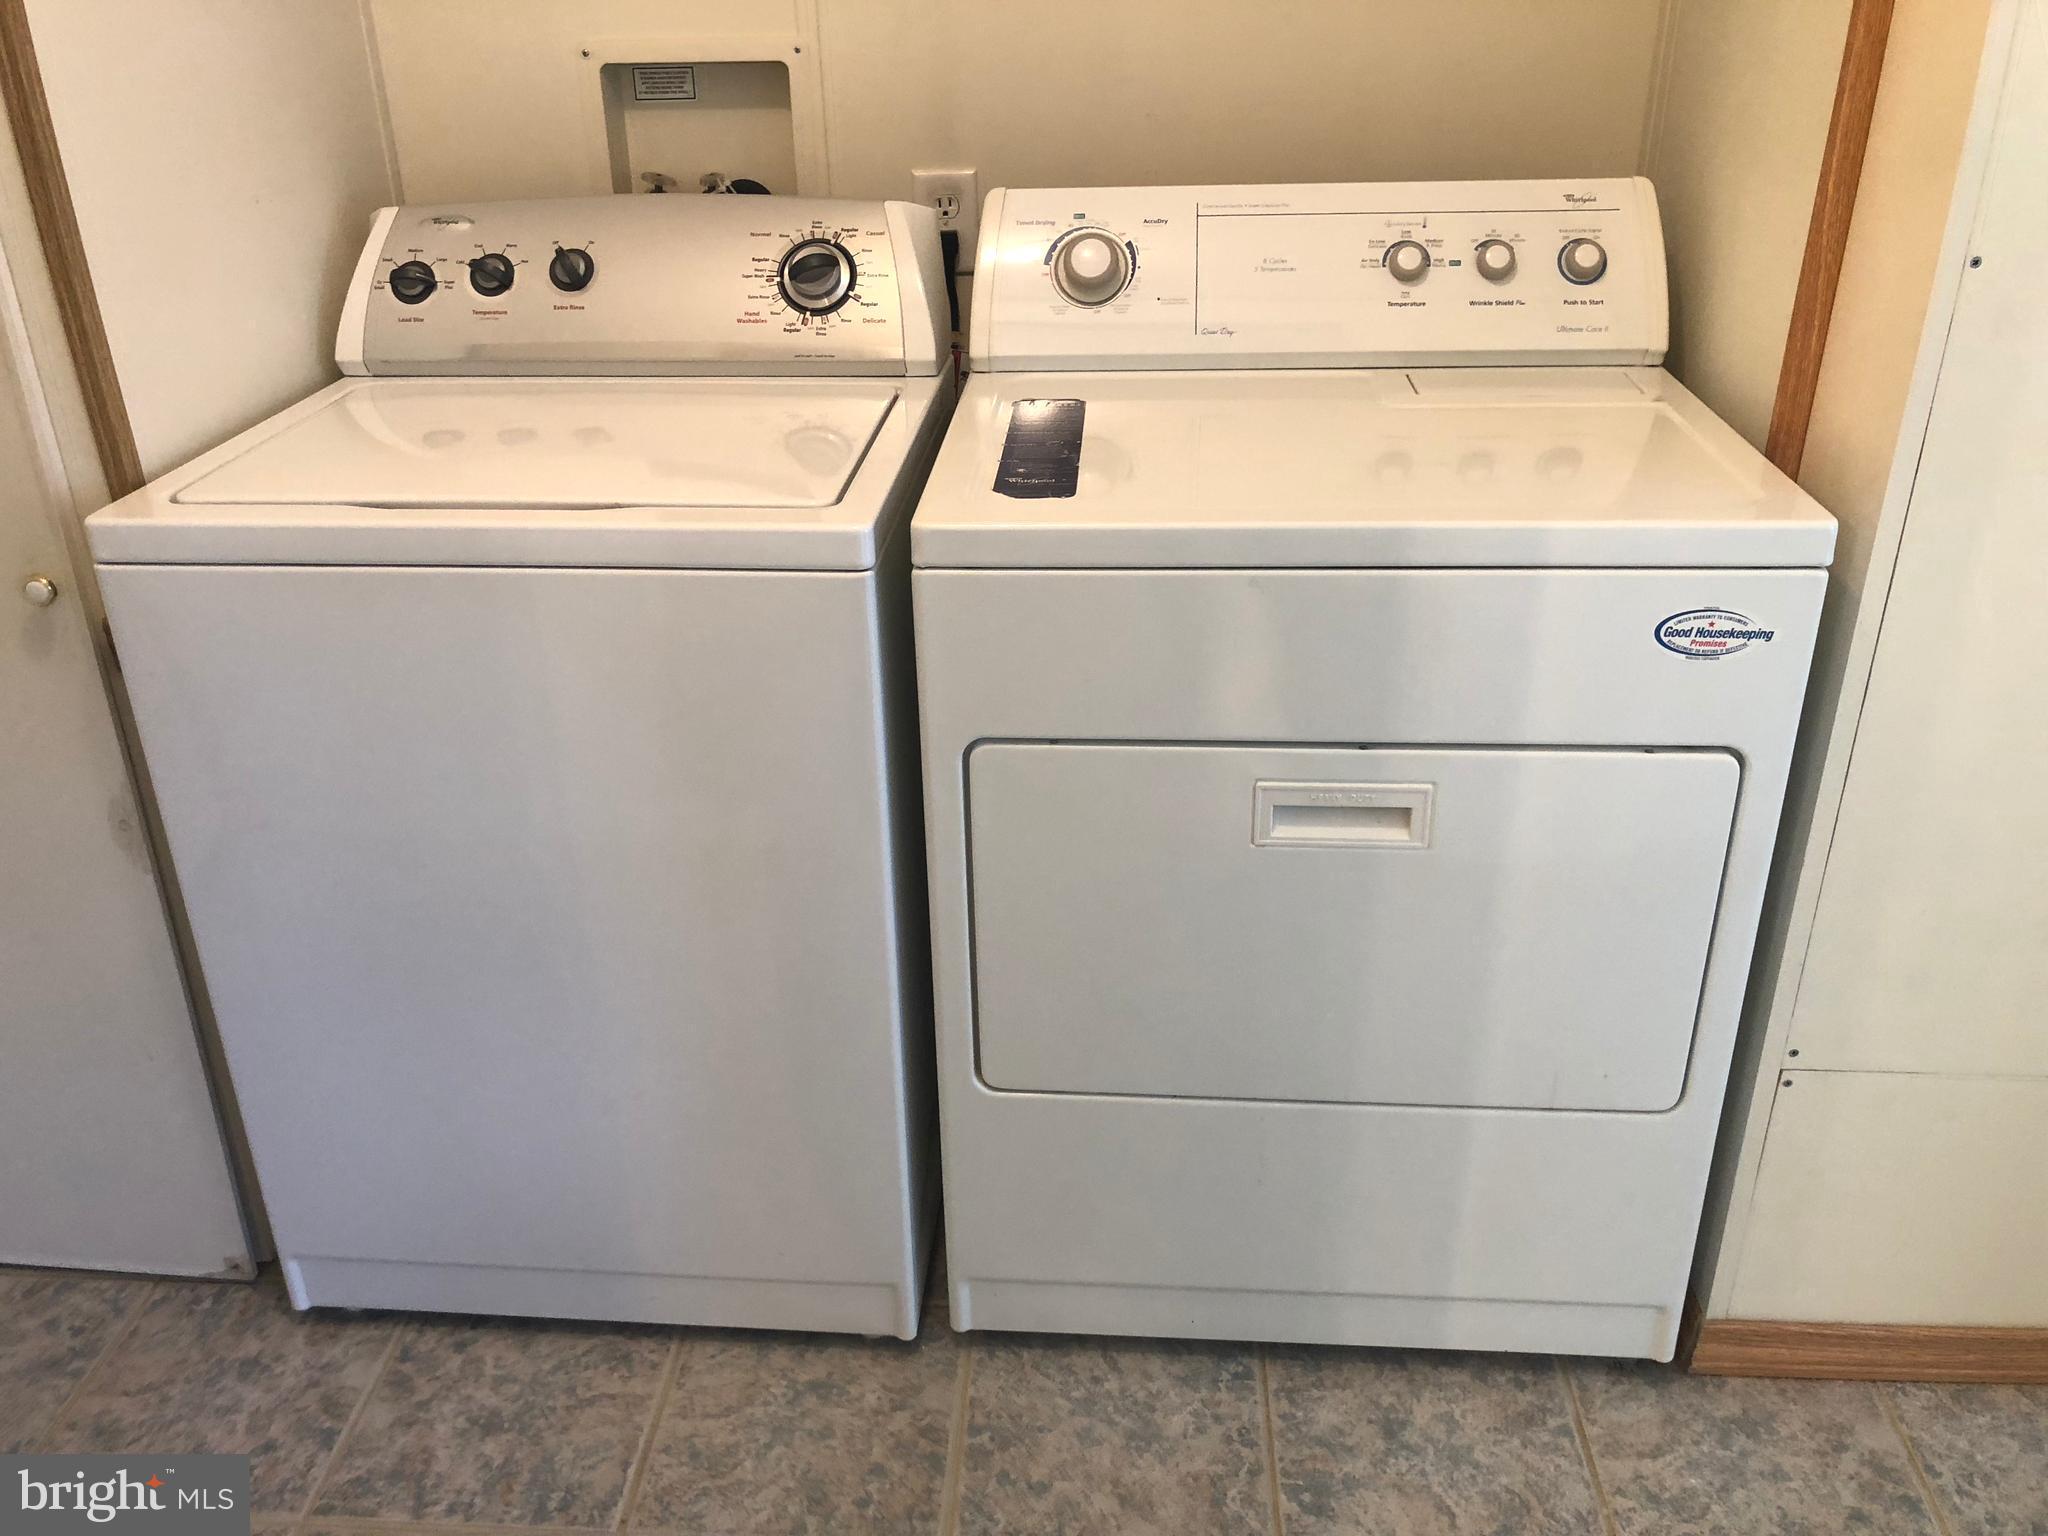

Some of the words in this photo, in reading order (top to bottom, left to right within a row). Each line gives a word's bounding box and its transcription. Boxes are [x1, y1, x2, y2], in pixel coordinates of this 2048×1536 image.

[1663, 626, 1694, 638] Good
[1694, 627, 1775, 642] Housekeeping
[1689, 639, 1728, 648] Promises
